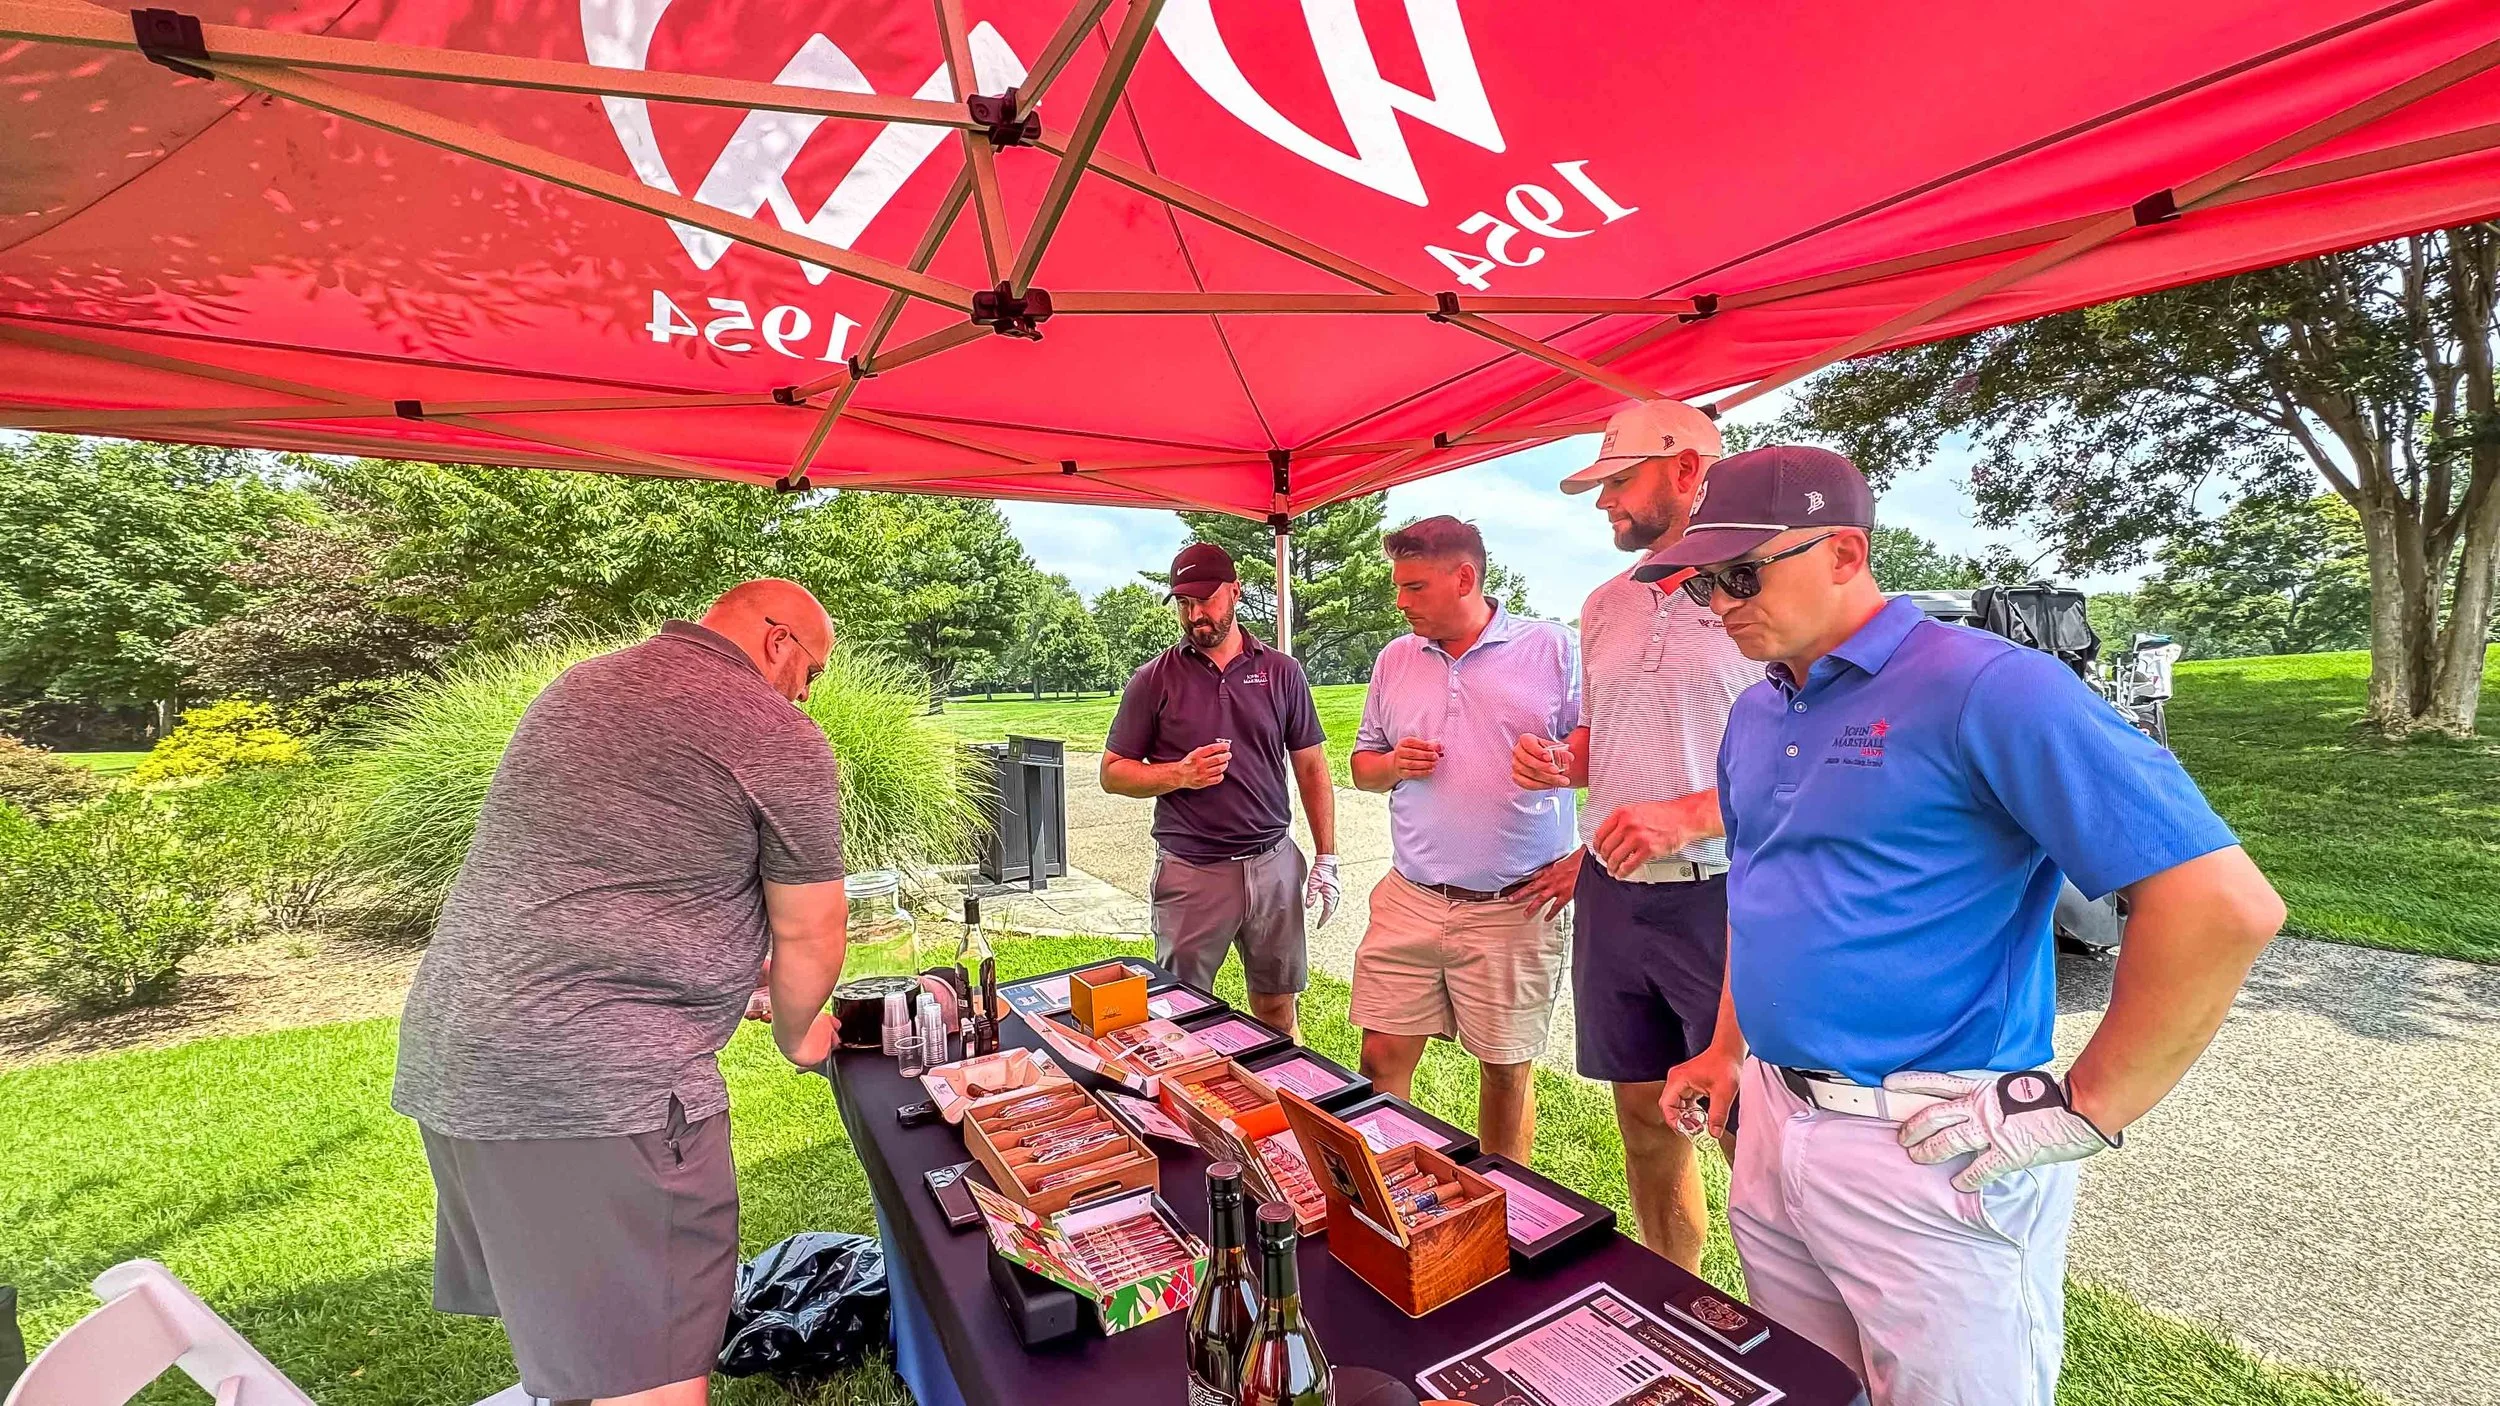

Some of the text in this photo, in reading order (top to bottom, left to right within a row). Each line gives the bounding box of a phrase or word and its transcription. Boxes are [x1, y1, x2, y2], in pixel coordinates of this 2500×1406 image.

[1843, 725, 1870, 738] JOHN
[1832, 738, 1884, 748] MARSHALL
[1650, 1338, 1662, 1348] DO
[1674, 1353, 1697, 1371] MADE
